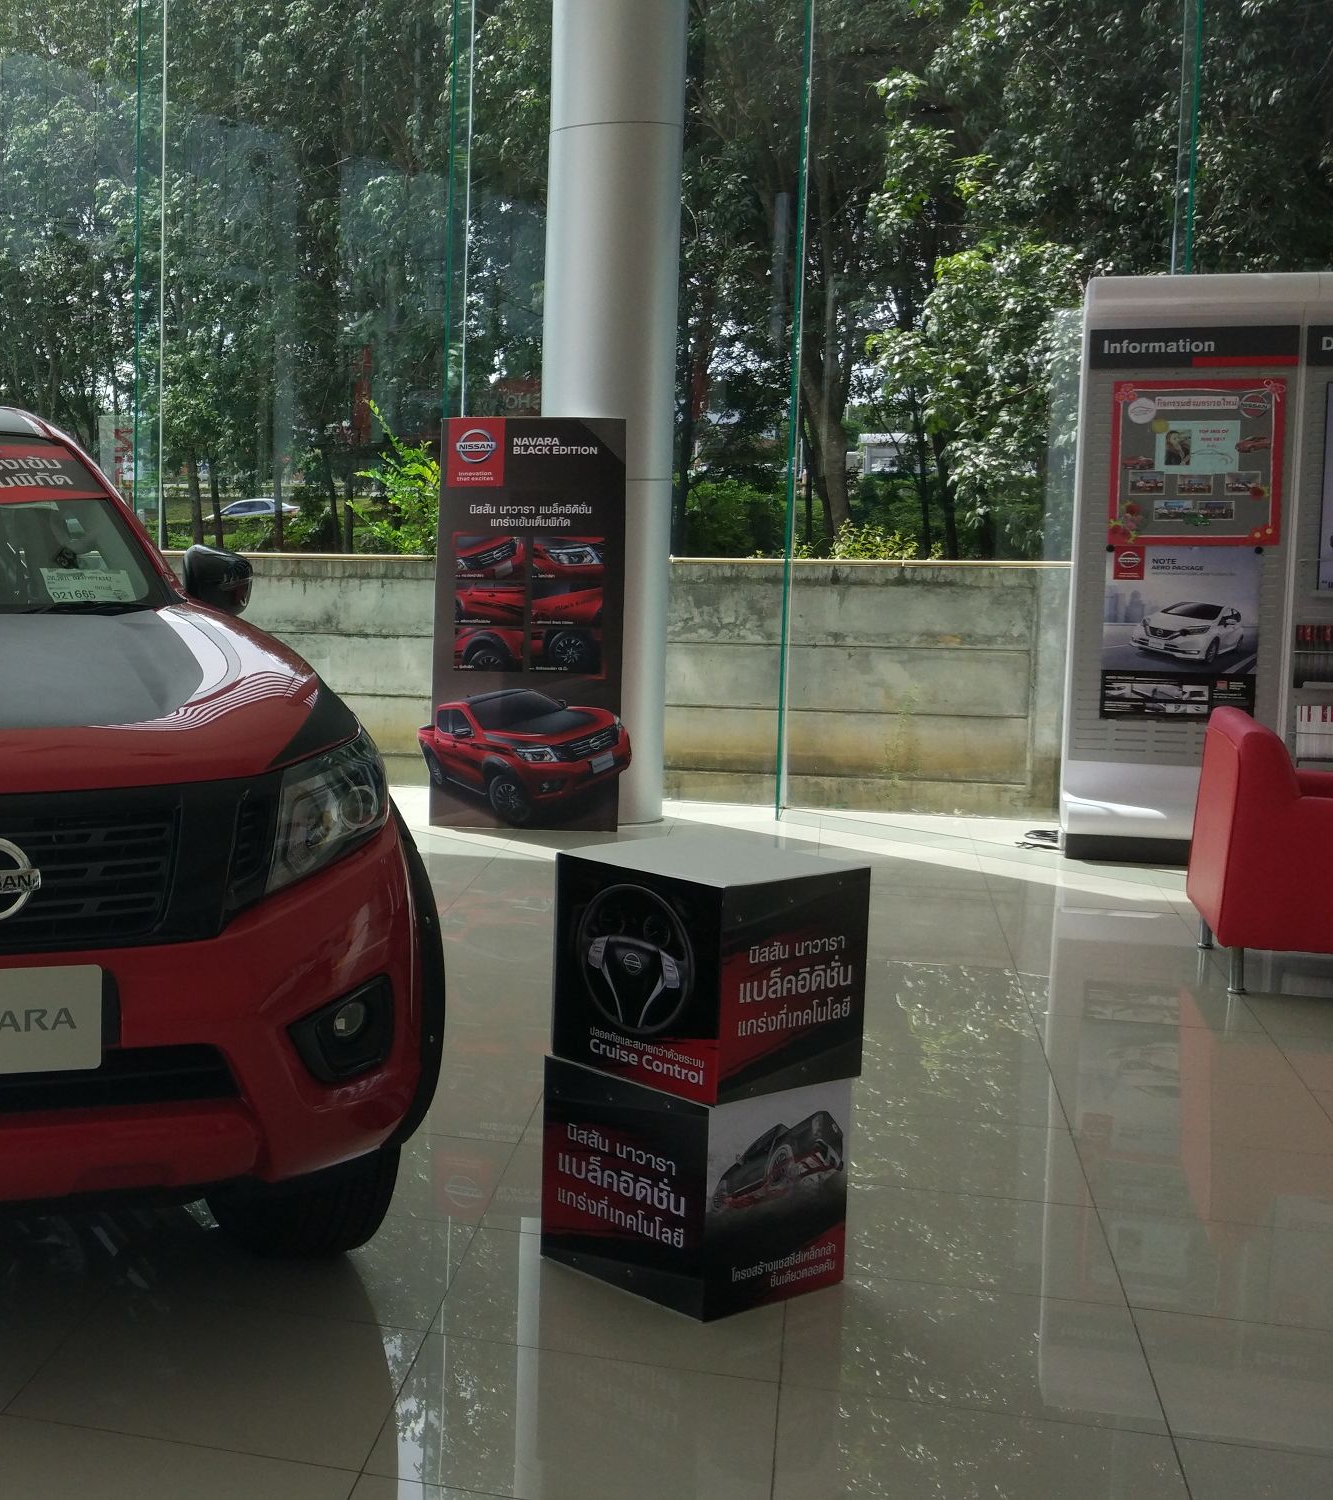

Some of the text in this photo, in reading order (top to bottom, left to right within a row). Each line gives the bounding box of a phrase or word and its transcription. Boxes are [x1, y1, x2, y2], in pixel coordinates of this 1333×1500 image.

[1103, 338, 1216, 354] Information
[513, 437, 560, 446] NAVARA
[513, 446, 598, 455] BLACK EDITION
[469, 503, 496, 514] นิสสัน
[500, 504, 535, 514] นาวารา
[52, 589, 96, 600] 021665
[749, 935, 845, 964] นิสสัน นาวารา
[738, 996, 851, 1036] แกร่งที่เทคโนโลยี
[589, 1038, 704, 1086] Cruise Control
[567, 1122, 676, 1176] นิสสัน นาวารา
[557, 1187, 684, 1249] แกร่งที่เทคโนโลยี
